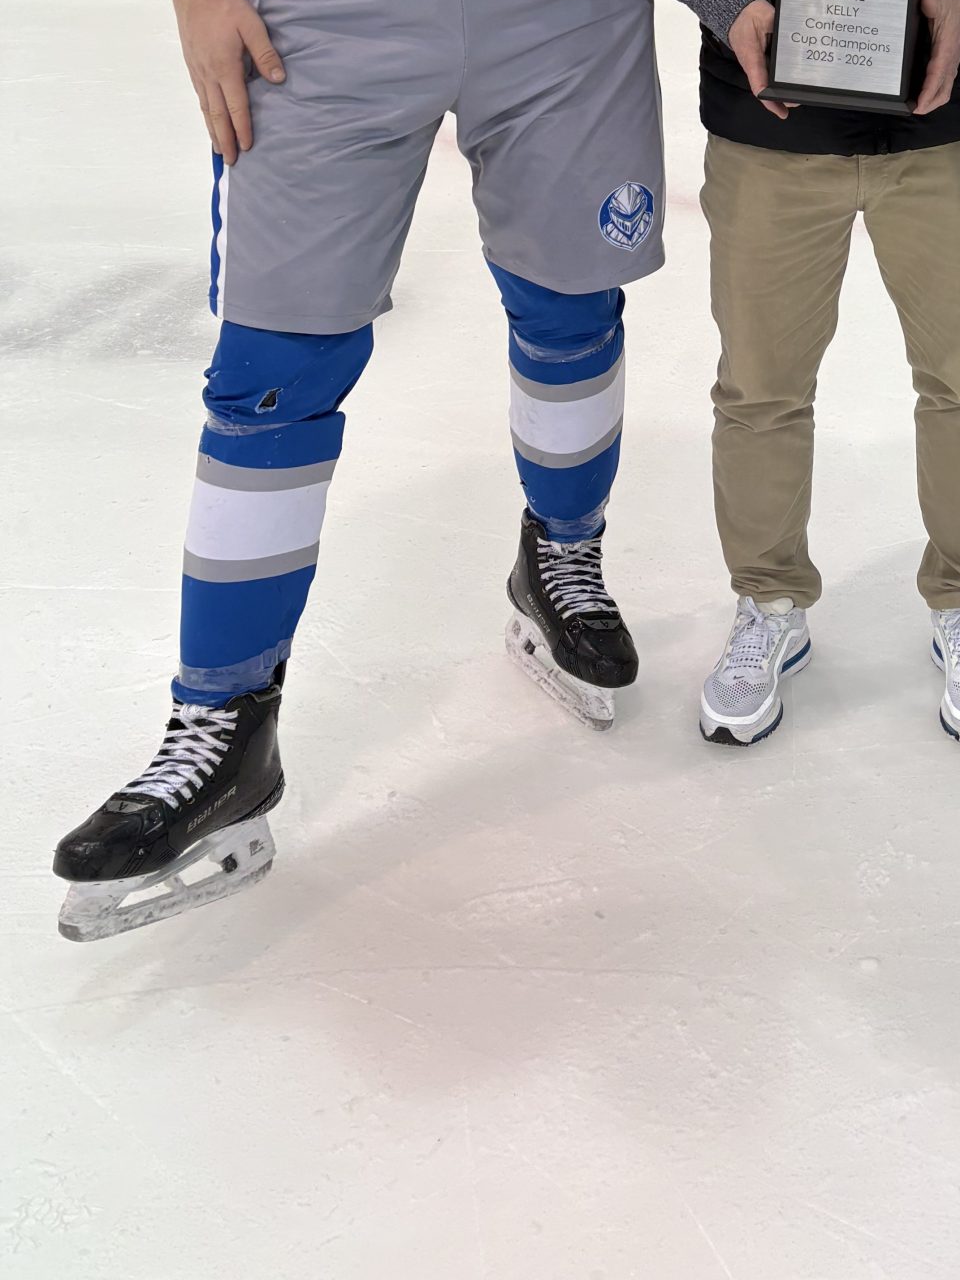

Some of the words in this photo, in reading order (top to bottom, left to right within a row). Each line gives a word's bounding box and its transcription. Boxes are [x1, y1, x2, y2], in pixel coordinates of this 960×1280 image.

[826, 4, 860, 18] KELLY
[805, 18, 879, 36] Conference
[791, 32, 817, 46] Cup
[821, 35, 891, 53] Champions
[806, 49, 834, 63] 2025
[845, 54, 873, 67] 2026
